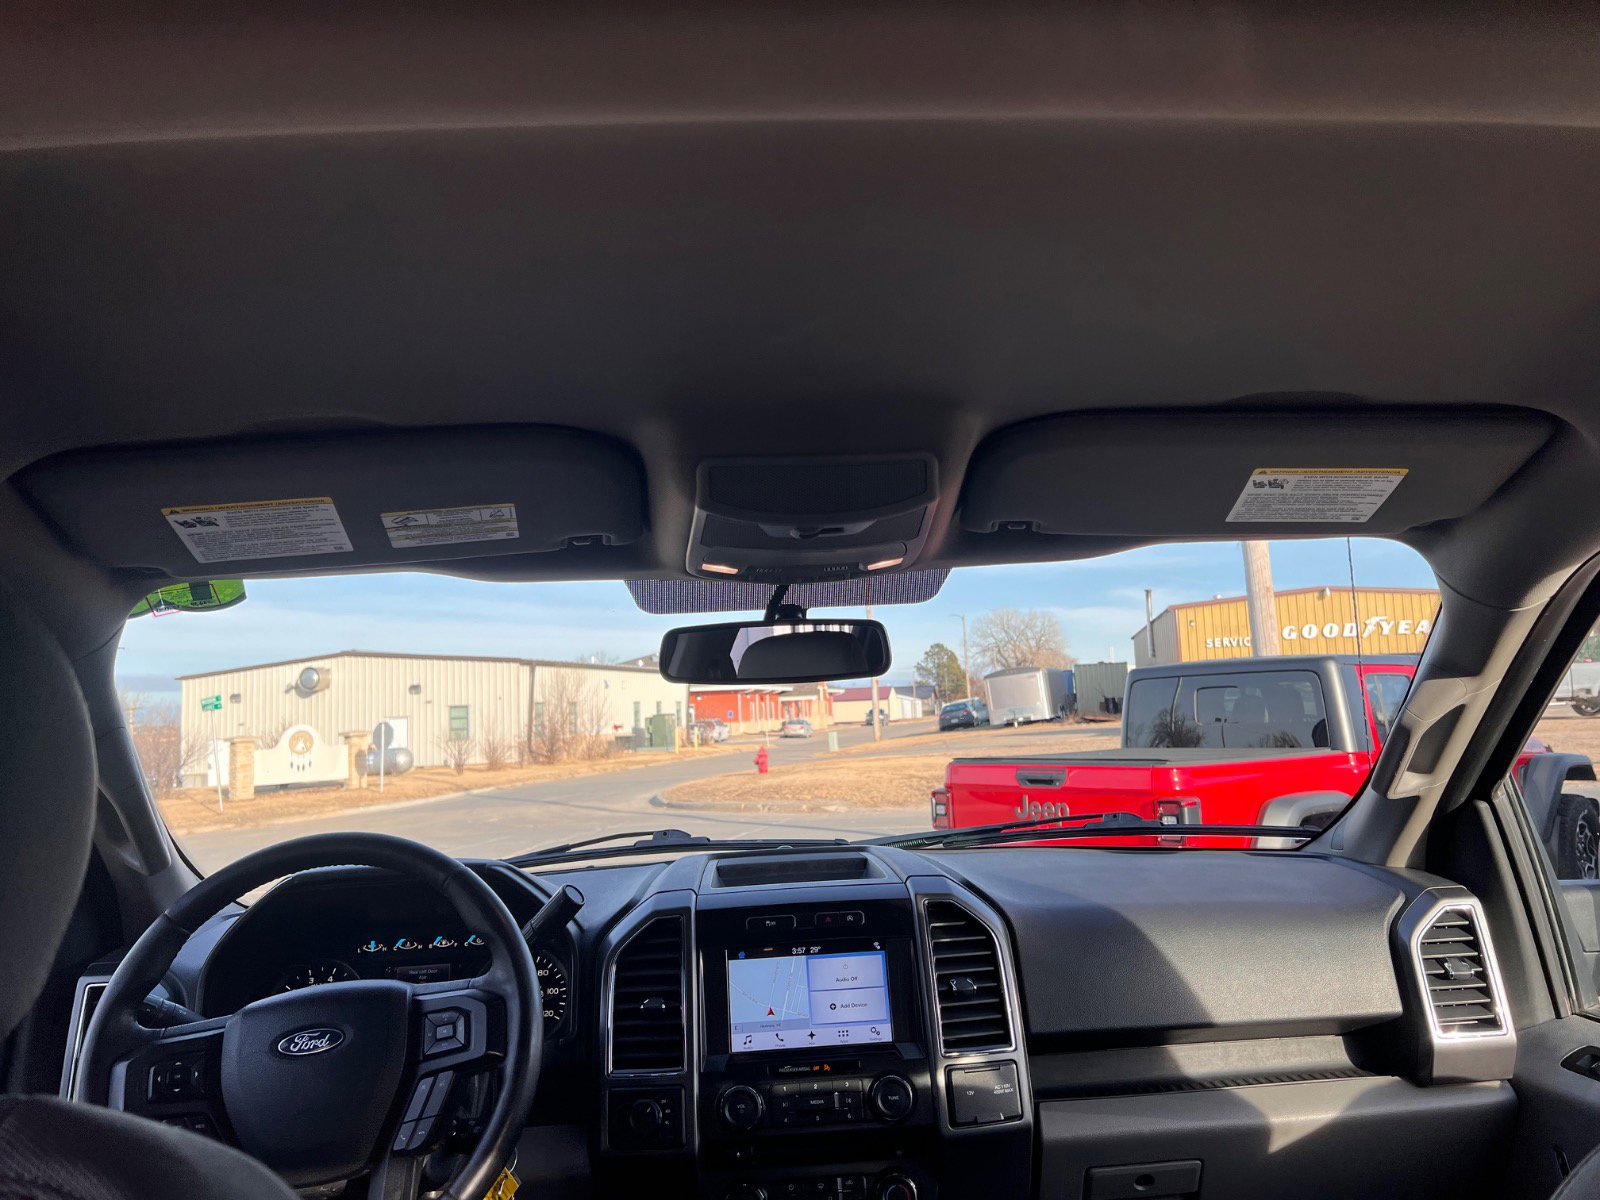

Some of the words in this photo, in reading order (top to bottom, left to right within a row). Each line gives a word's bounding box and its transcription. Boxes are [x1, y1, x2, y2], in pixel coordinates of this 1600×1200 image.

[1281, 616, 1431, 640] GOODYEA
[1206, 636, 1251, 648] SERVIC
[1015, 795, 1070, 827] Jeep
[290, 1032, 330, 1052] Ford
